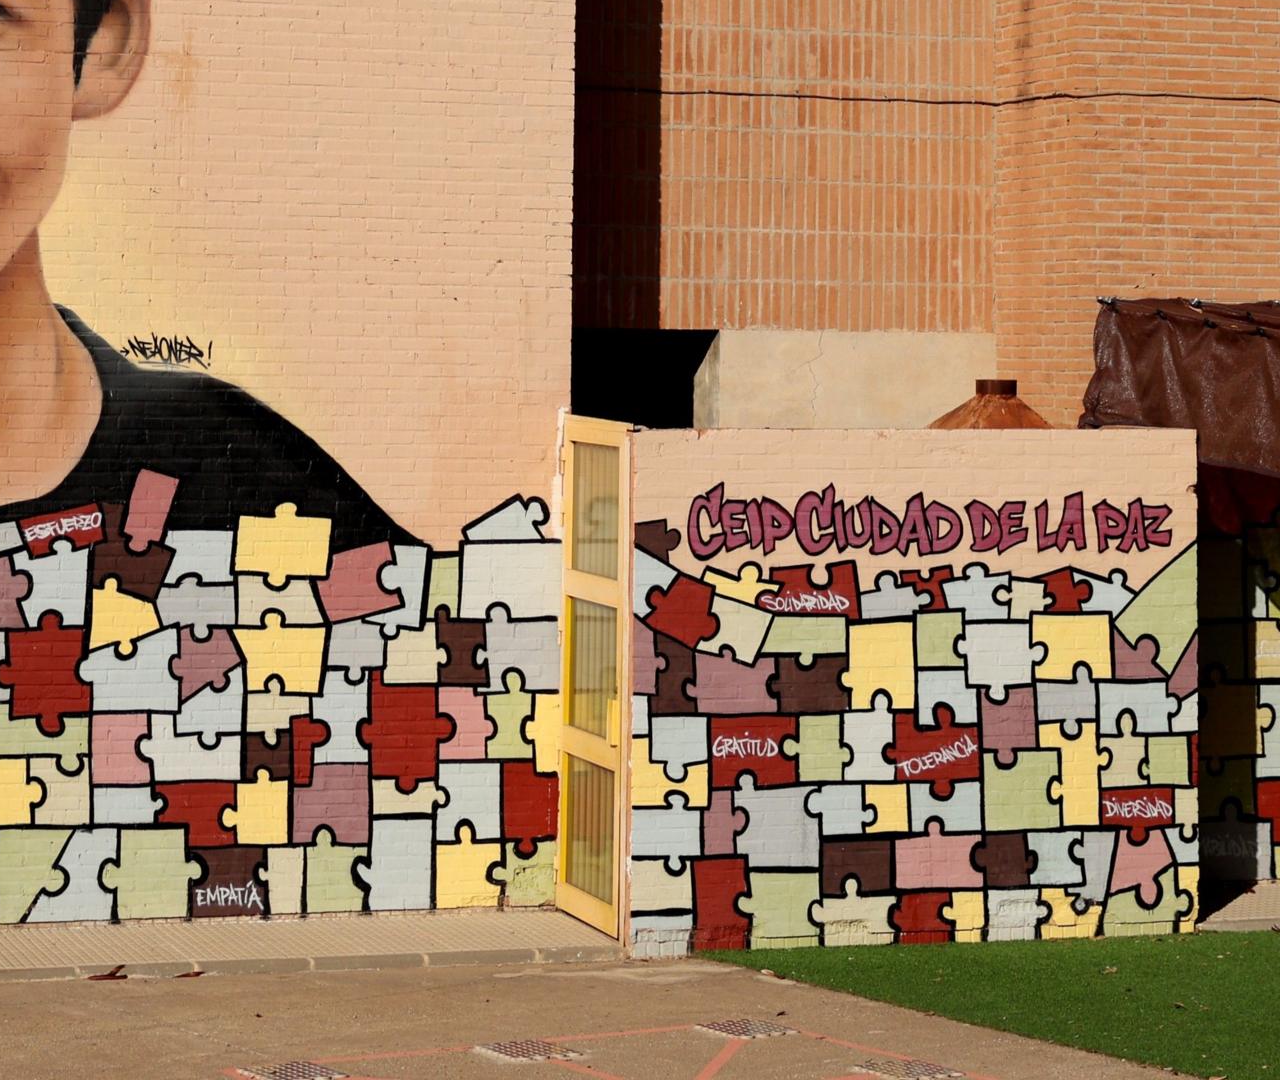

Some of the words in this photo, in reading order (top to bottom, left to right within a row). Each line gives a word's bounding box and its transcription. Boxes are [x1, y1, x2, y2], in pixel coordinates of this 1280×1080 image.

[688, 482, 794, 560] CEIP
[795, 482, 963, 557] CIUDAD
[964, 499, 1028, 555] DE
[1035, 490, 1087, 553] LA
[1092, 497, 1172, 554] PAZ
[195, 880, 264, 910] EMPATÍA
